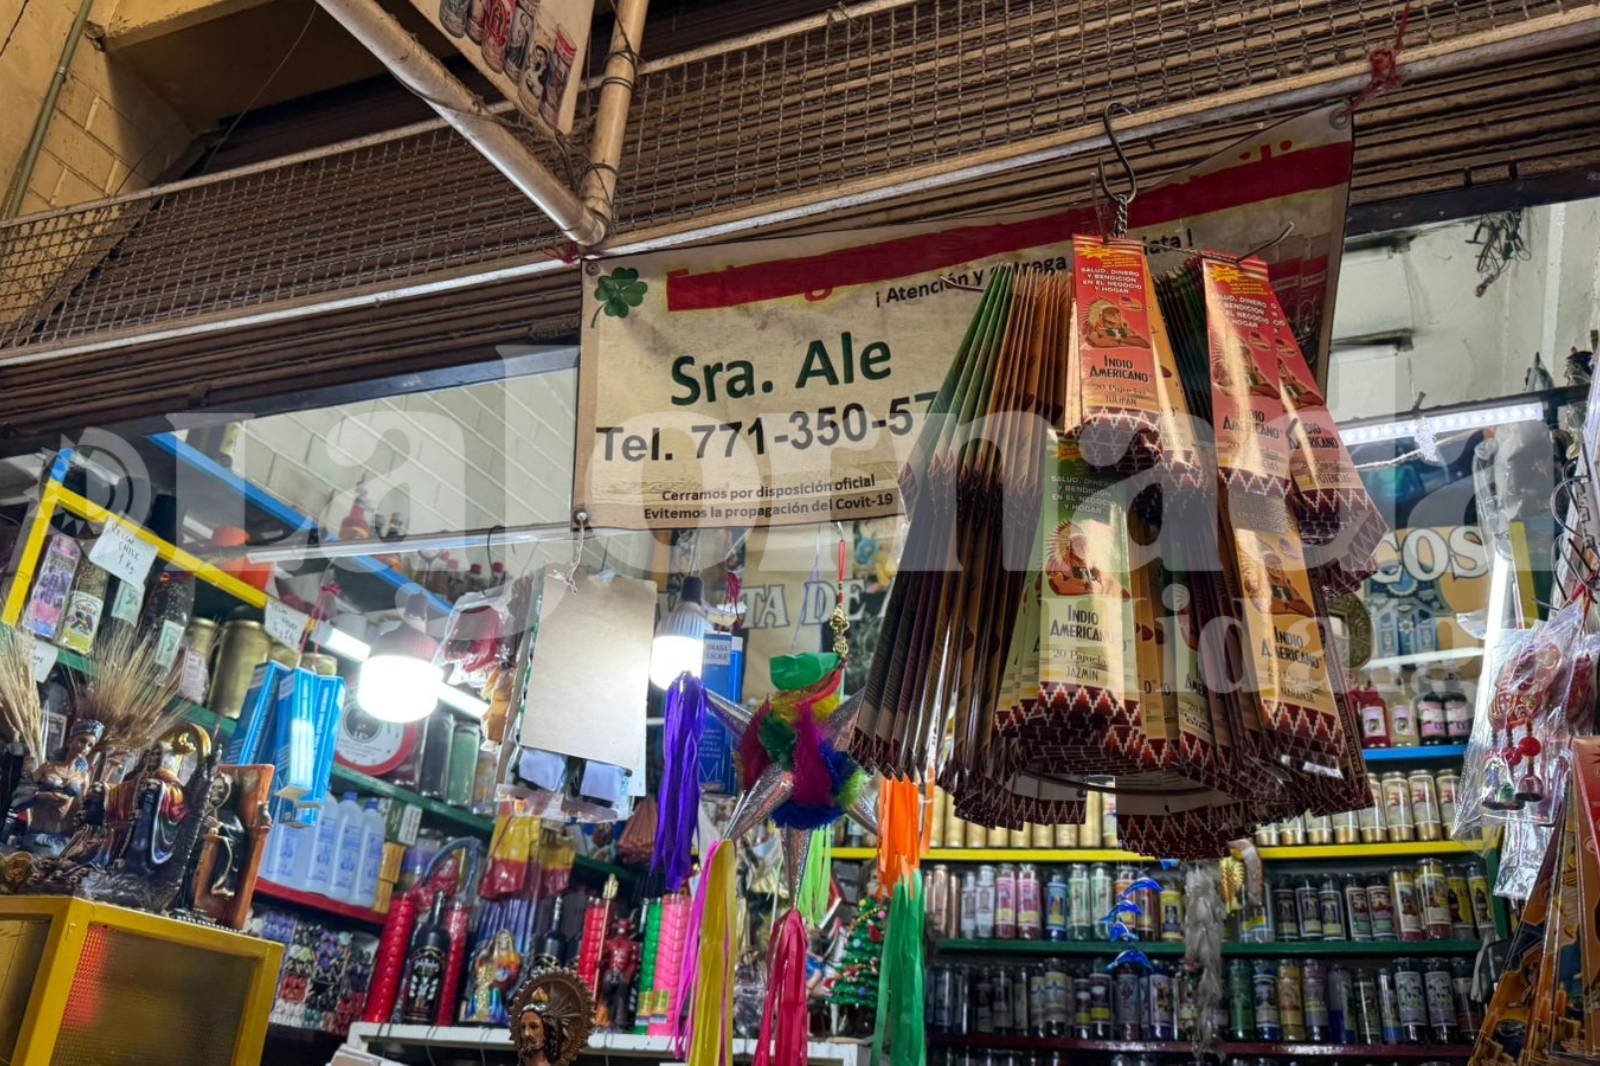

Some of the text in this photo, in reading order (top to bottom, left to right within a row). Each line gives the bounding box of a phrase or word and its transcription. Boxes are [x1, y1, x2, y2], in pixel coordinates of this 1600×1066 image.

[1110, 269, 1140, 277] DINERO
[886, 274, 969, 304] Atención
[972, 270, 984, 287] y
[1107, 281, 1142, 290] NEGOCIO
[671, 331, 892, 406] Sra. Ale
[1089, 365, 1149, 382] AMERICANO
[1104, 355, 1133, 369] INDIO
[595, 426, 673, 462] Tel.
[662, 474, 876, 503] Cerramos por disposición oficial
[643, 493, 893, 522] Evitemos la propagación del Covit-19
[1068, 604, 1099, 625] INDIO
[1273, 625, 1303, 649] INDIO
